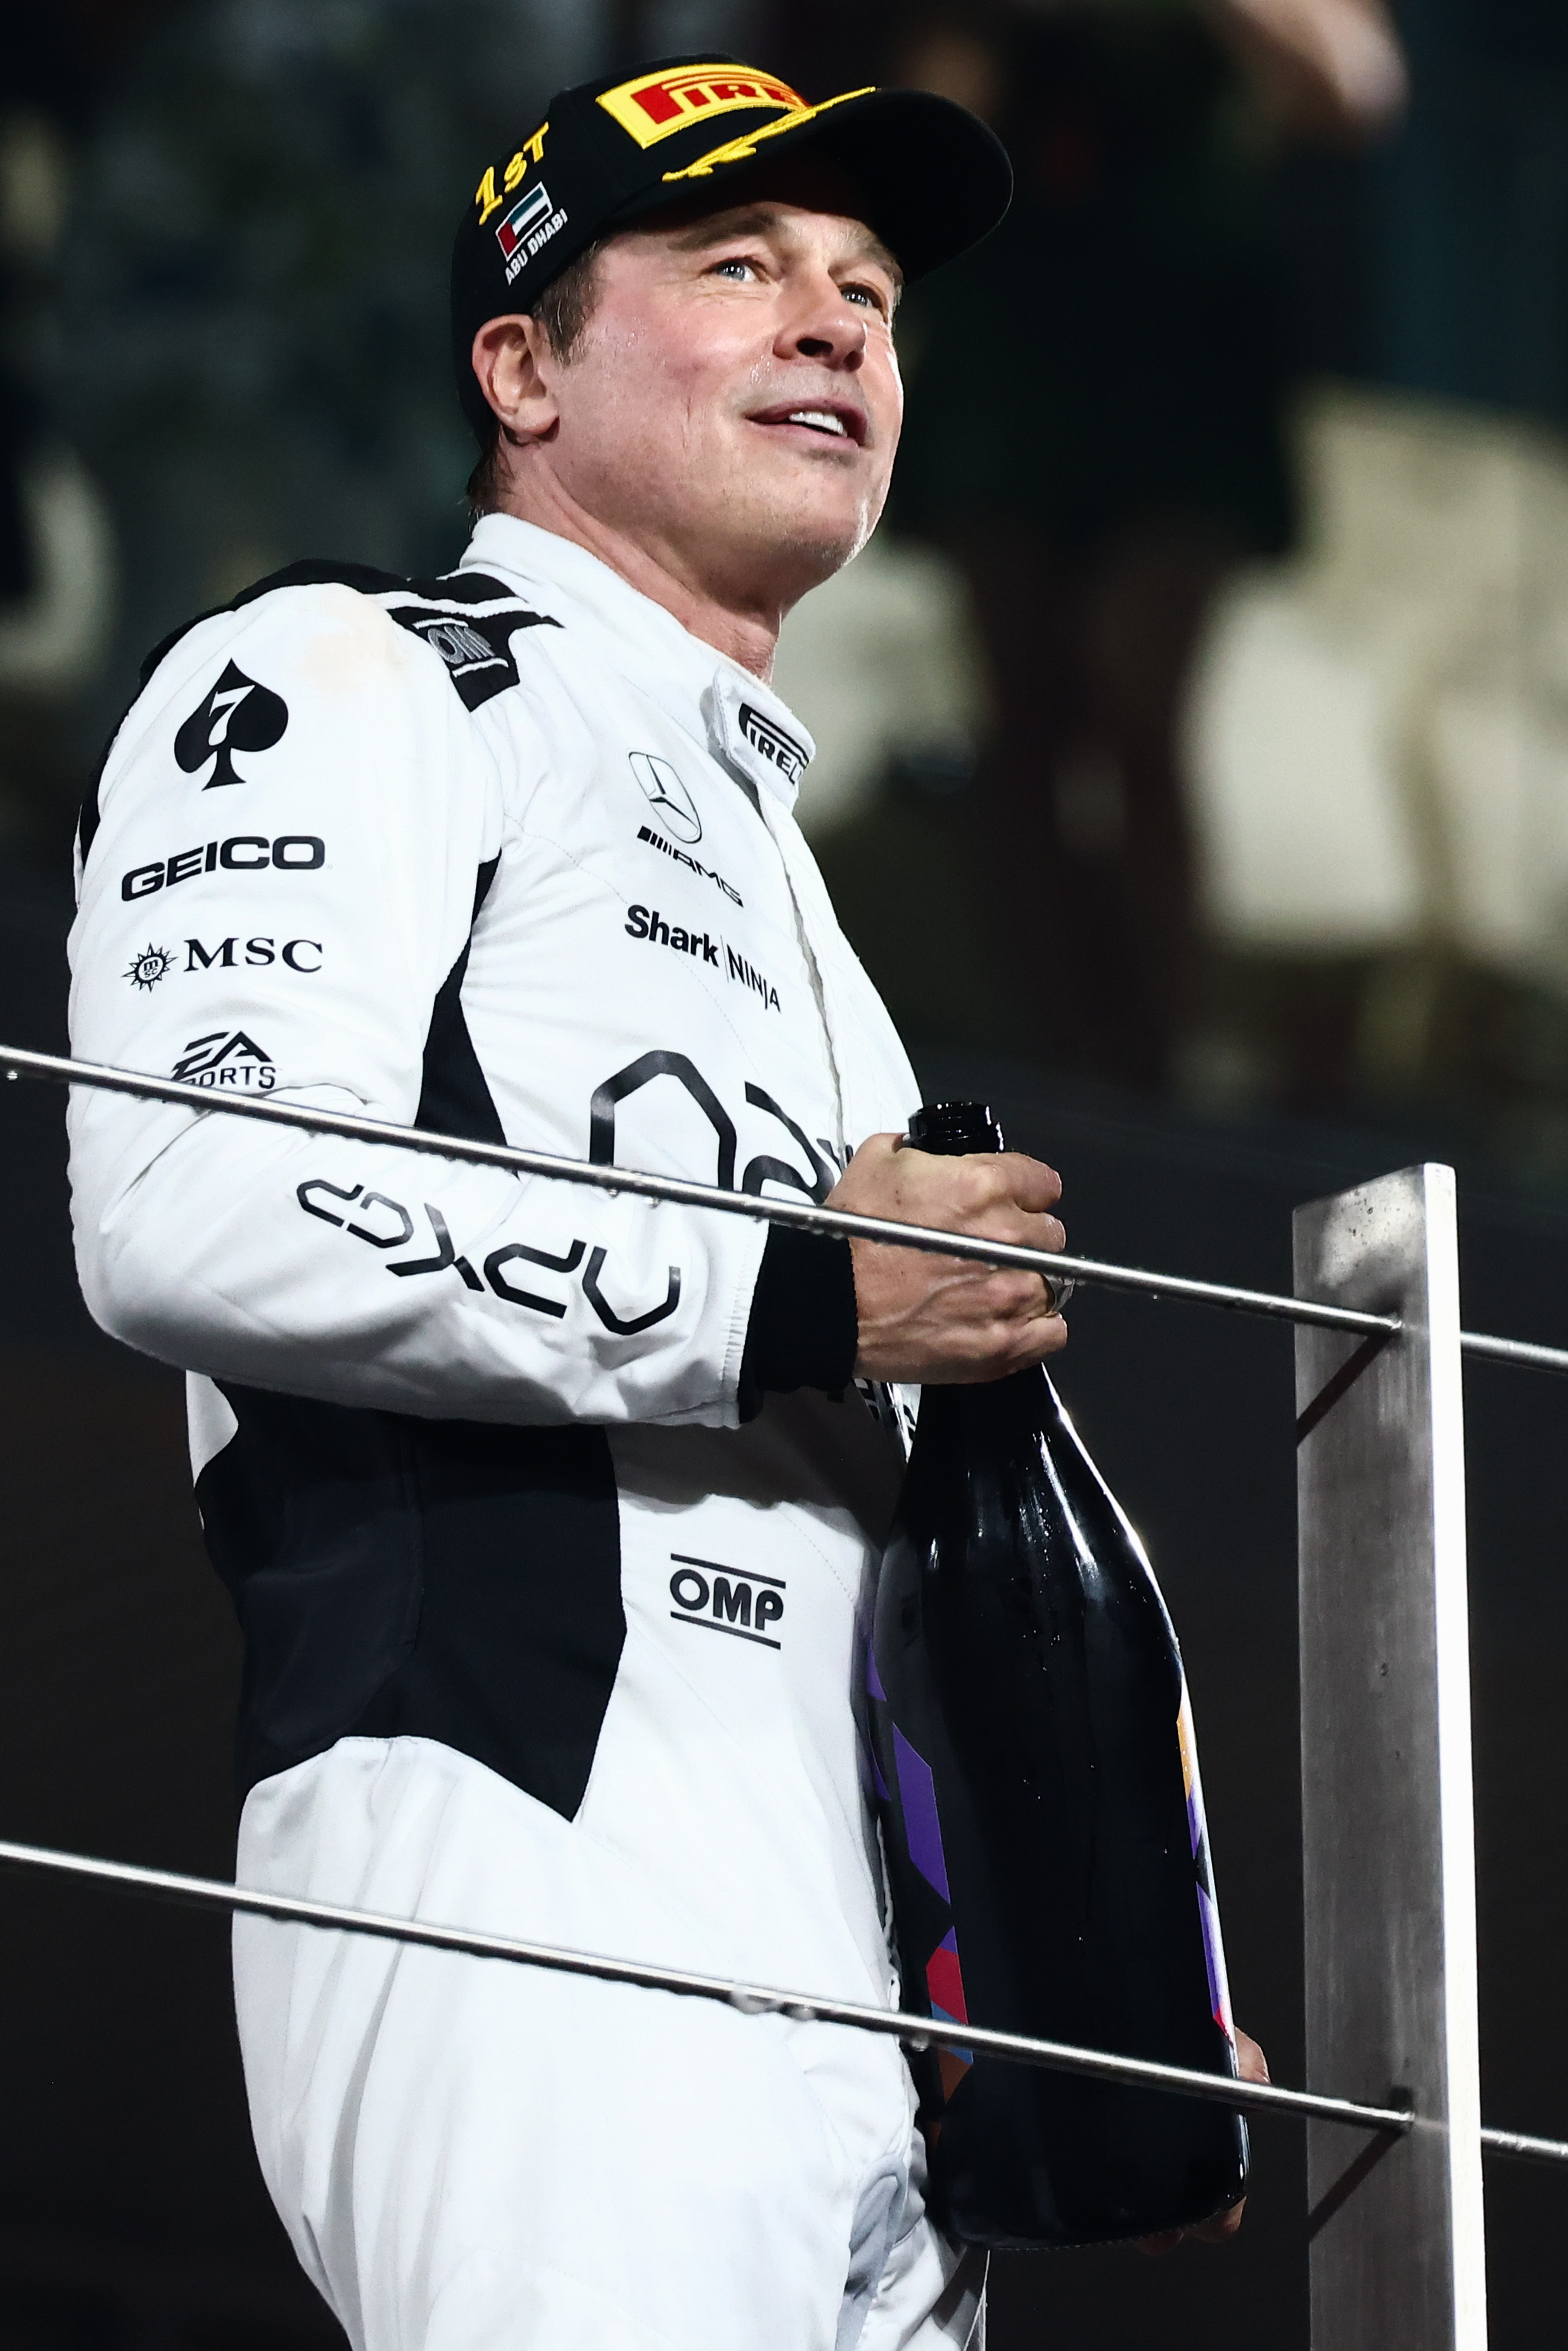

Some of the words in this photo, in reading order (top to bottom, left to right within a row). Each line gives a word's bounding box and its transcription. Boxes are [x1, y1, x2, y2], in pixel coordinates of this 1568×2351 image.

[475, 121, 550, 226] 1ST
[504, 248, 529, 286] ABU
[526, 207, 569, 257] DHABI
[208, 684, 256, 746] 7
[121, 836, 326, 902] GEICO
[182, 937, 323, 973] MSC
[624, 904, 719, 968] Shark
[726, 943, 782, 1015] NINJA
[170, 1030, 274, 1081] EA
[669, 1568, 784, 1632] OMP
